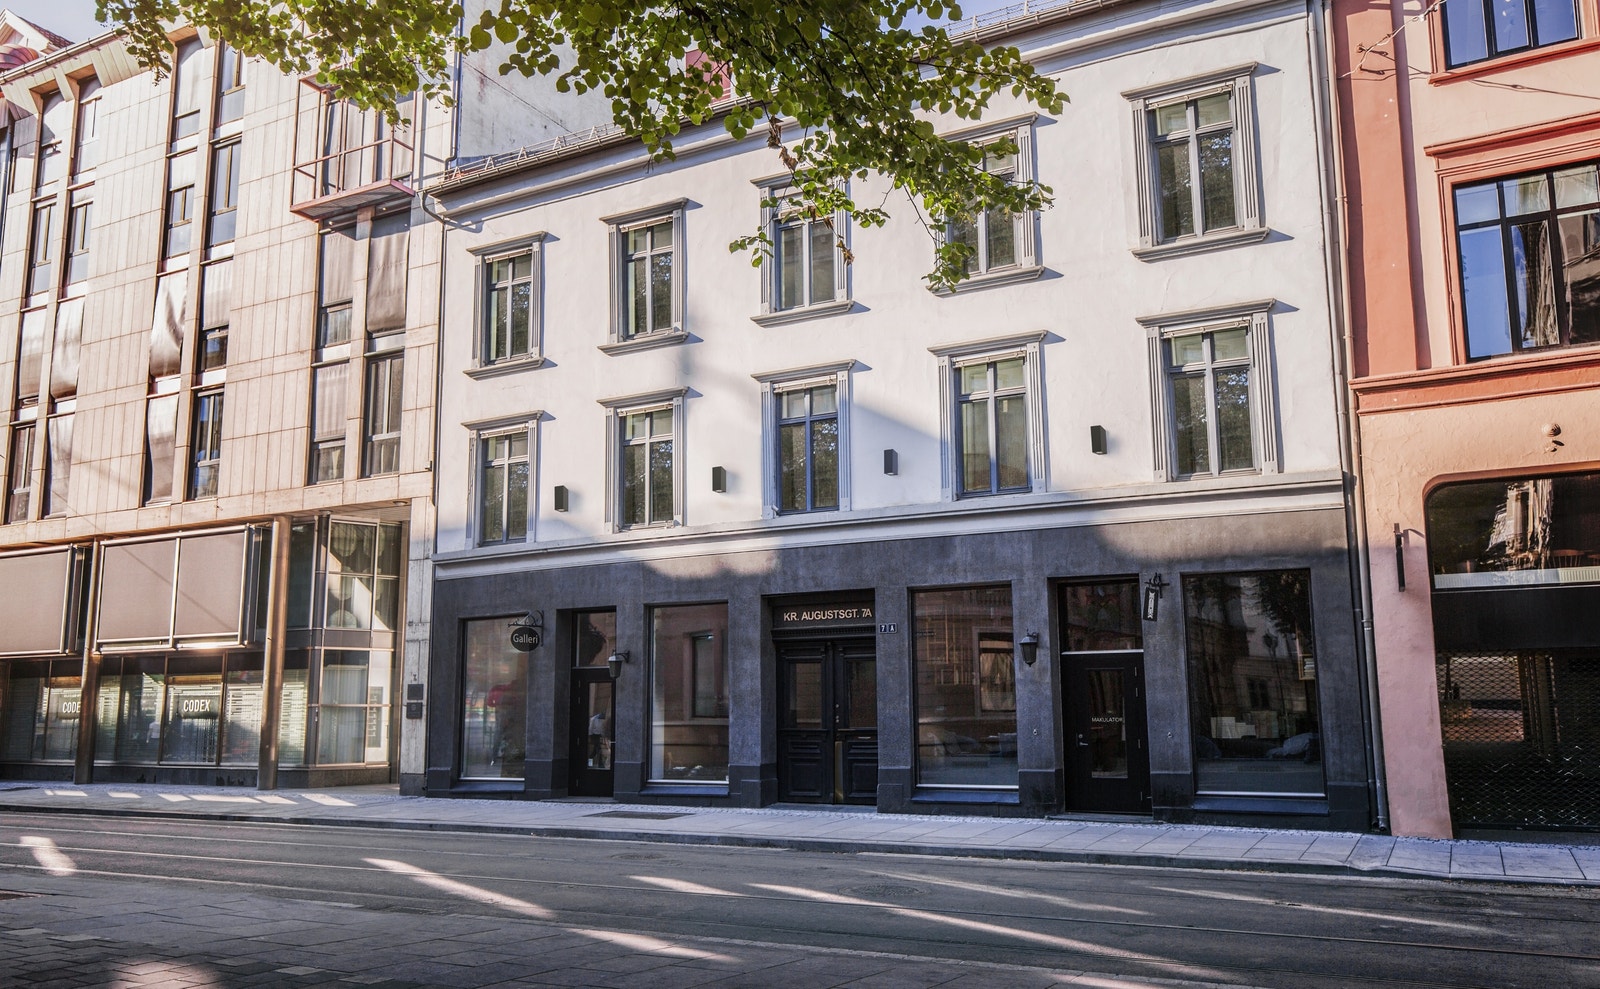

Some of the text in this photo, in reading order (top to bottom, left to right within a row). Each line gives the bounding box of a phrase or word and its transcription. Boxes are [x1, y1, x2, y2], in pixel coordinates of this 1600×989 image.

[783, 608, 873, 621] KR. AUGUSTSGT. 7A
[512, 633, 538, 644] Galleri
[62, 701, 82, 714] CODE
[183, 699, 211, 712] CODEX
